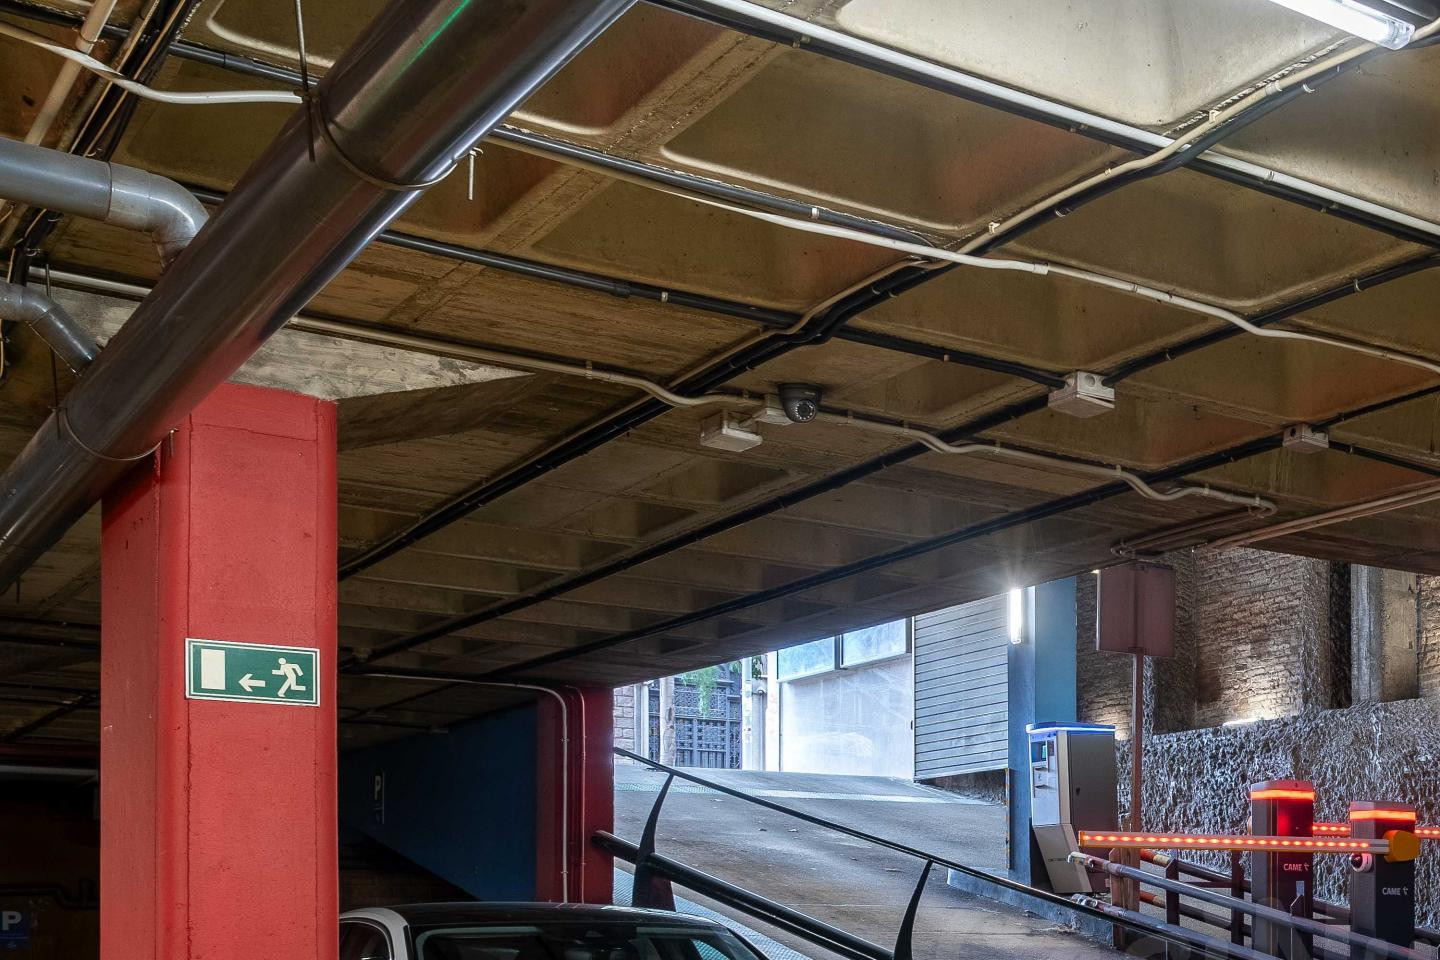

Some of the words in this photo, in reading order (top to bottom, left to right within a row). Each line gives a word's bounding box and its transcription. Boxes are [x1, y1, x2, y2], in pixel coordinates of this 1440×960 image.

[1283, 863, 1303, 871] CAME
[1382, 887, 1401, 895] CAME
[2, 911, 22, 930] P
